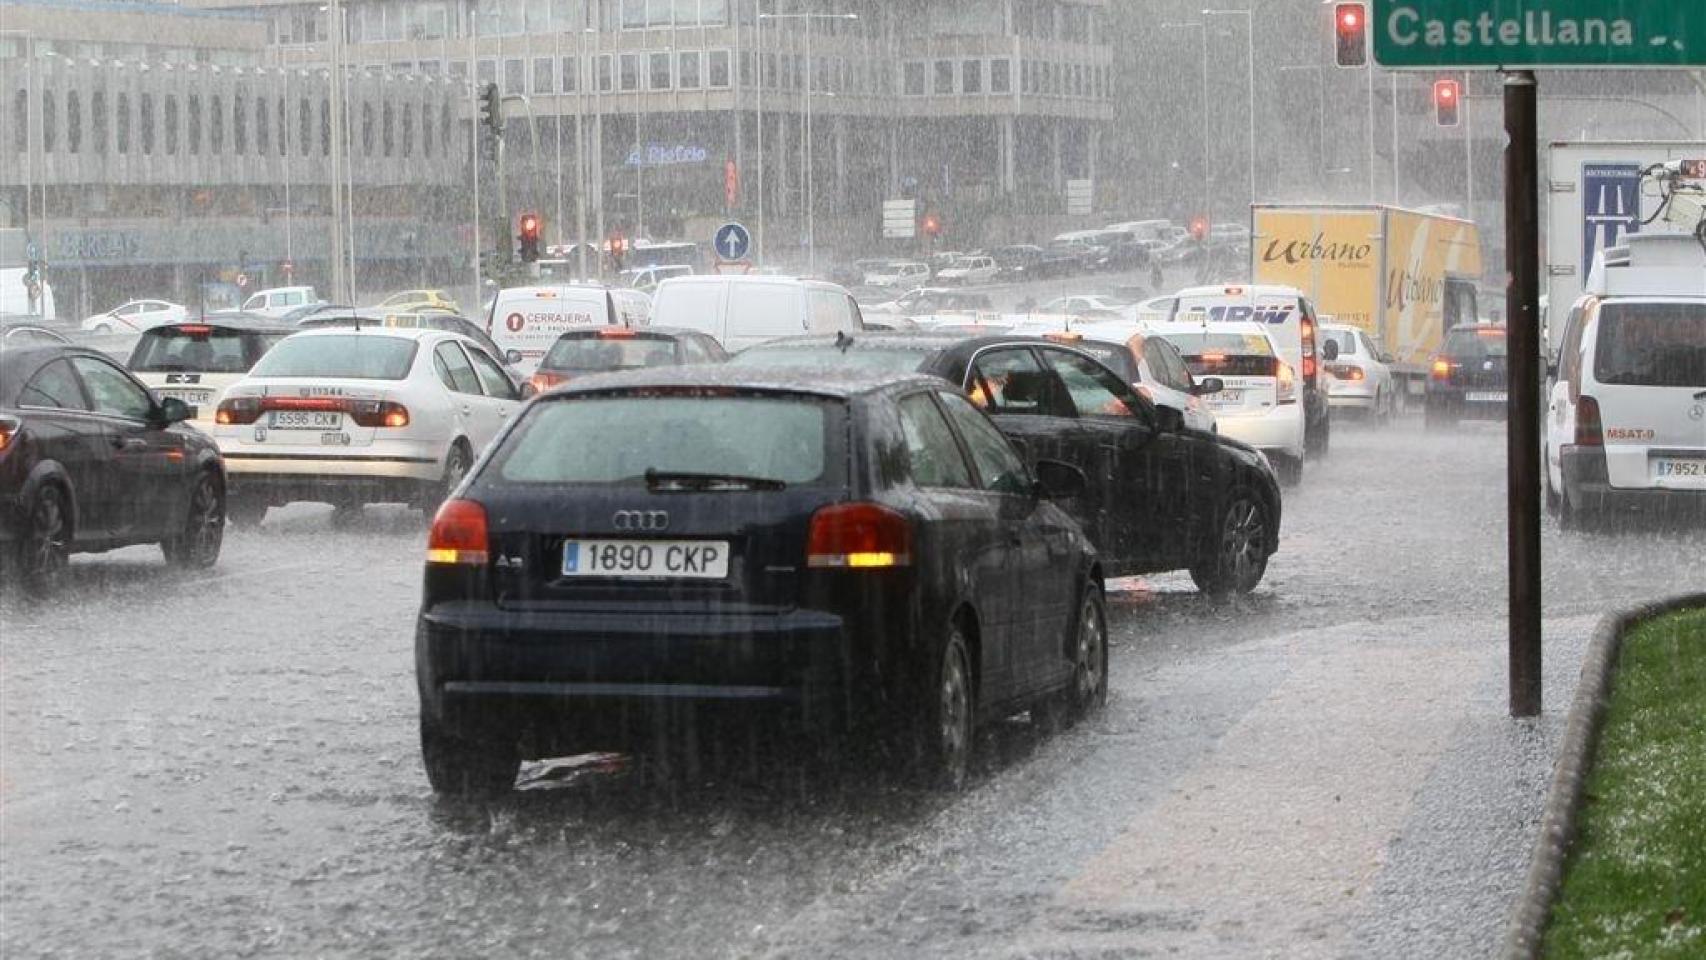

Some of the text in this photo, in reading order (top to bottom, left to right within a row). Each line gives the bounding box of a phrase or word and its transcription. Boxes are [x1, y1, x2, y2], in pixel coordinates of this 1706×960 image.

[1387, 7, 1633, 46] Castellana
[1262, 232, 1371, 263] Urbano
[1665, 462, 1699, 476] 7952
[664, 545, 719, 574] CKP
